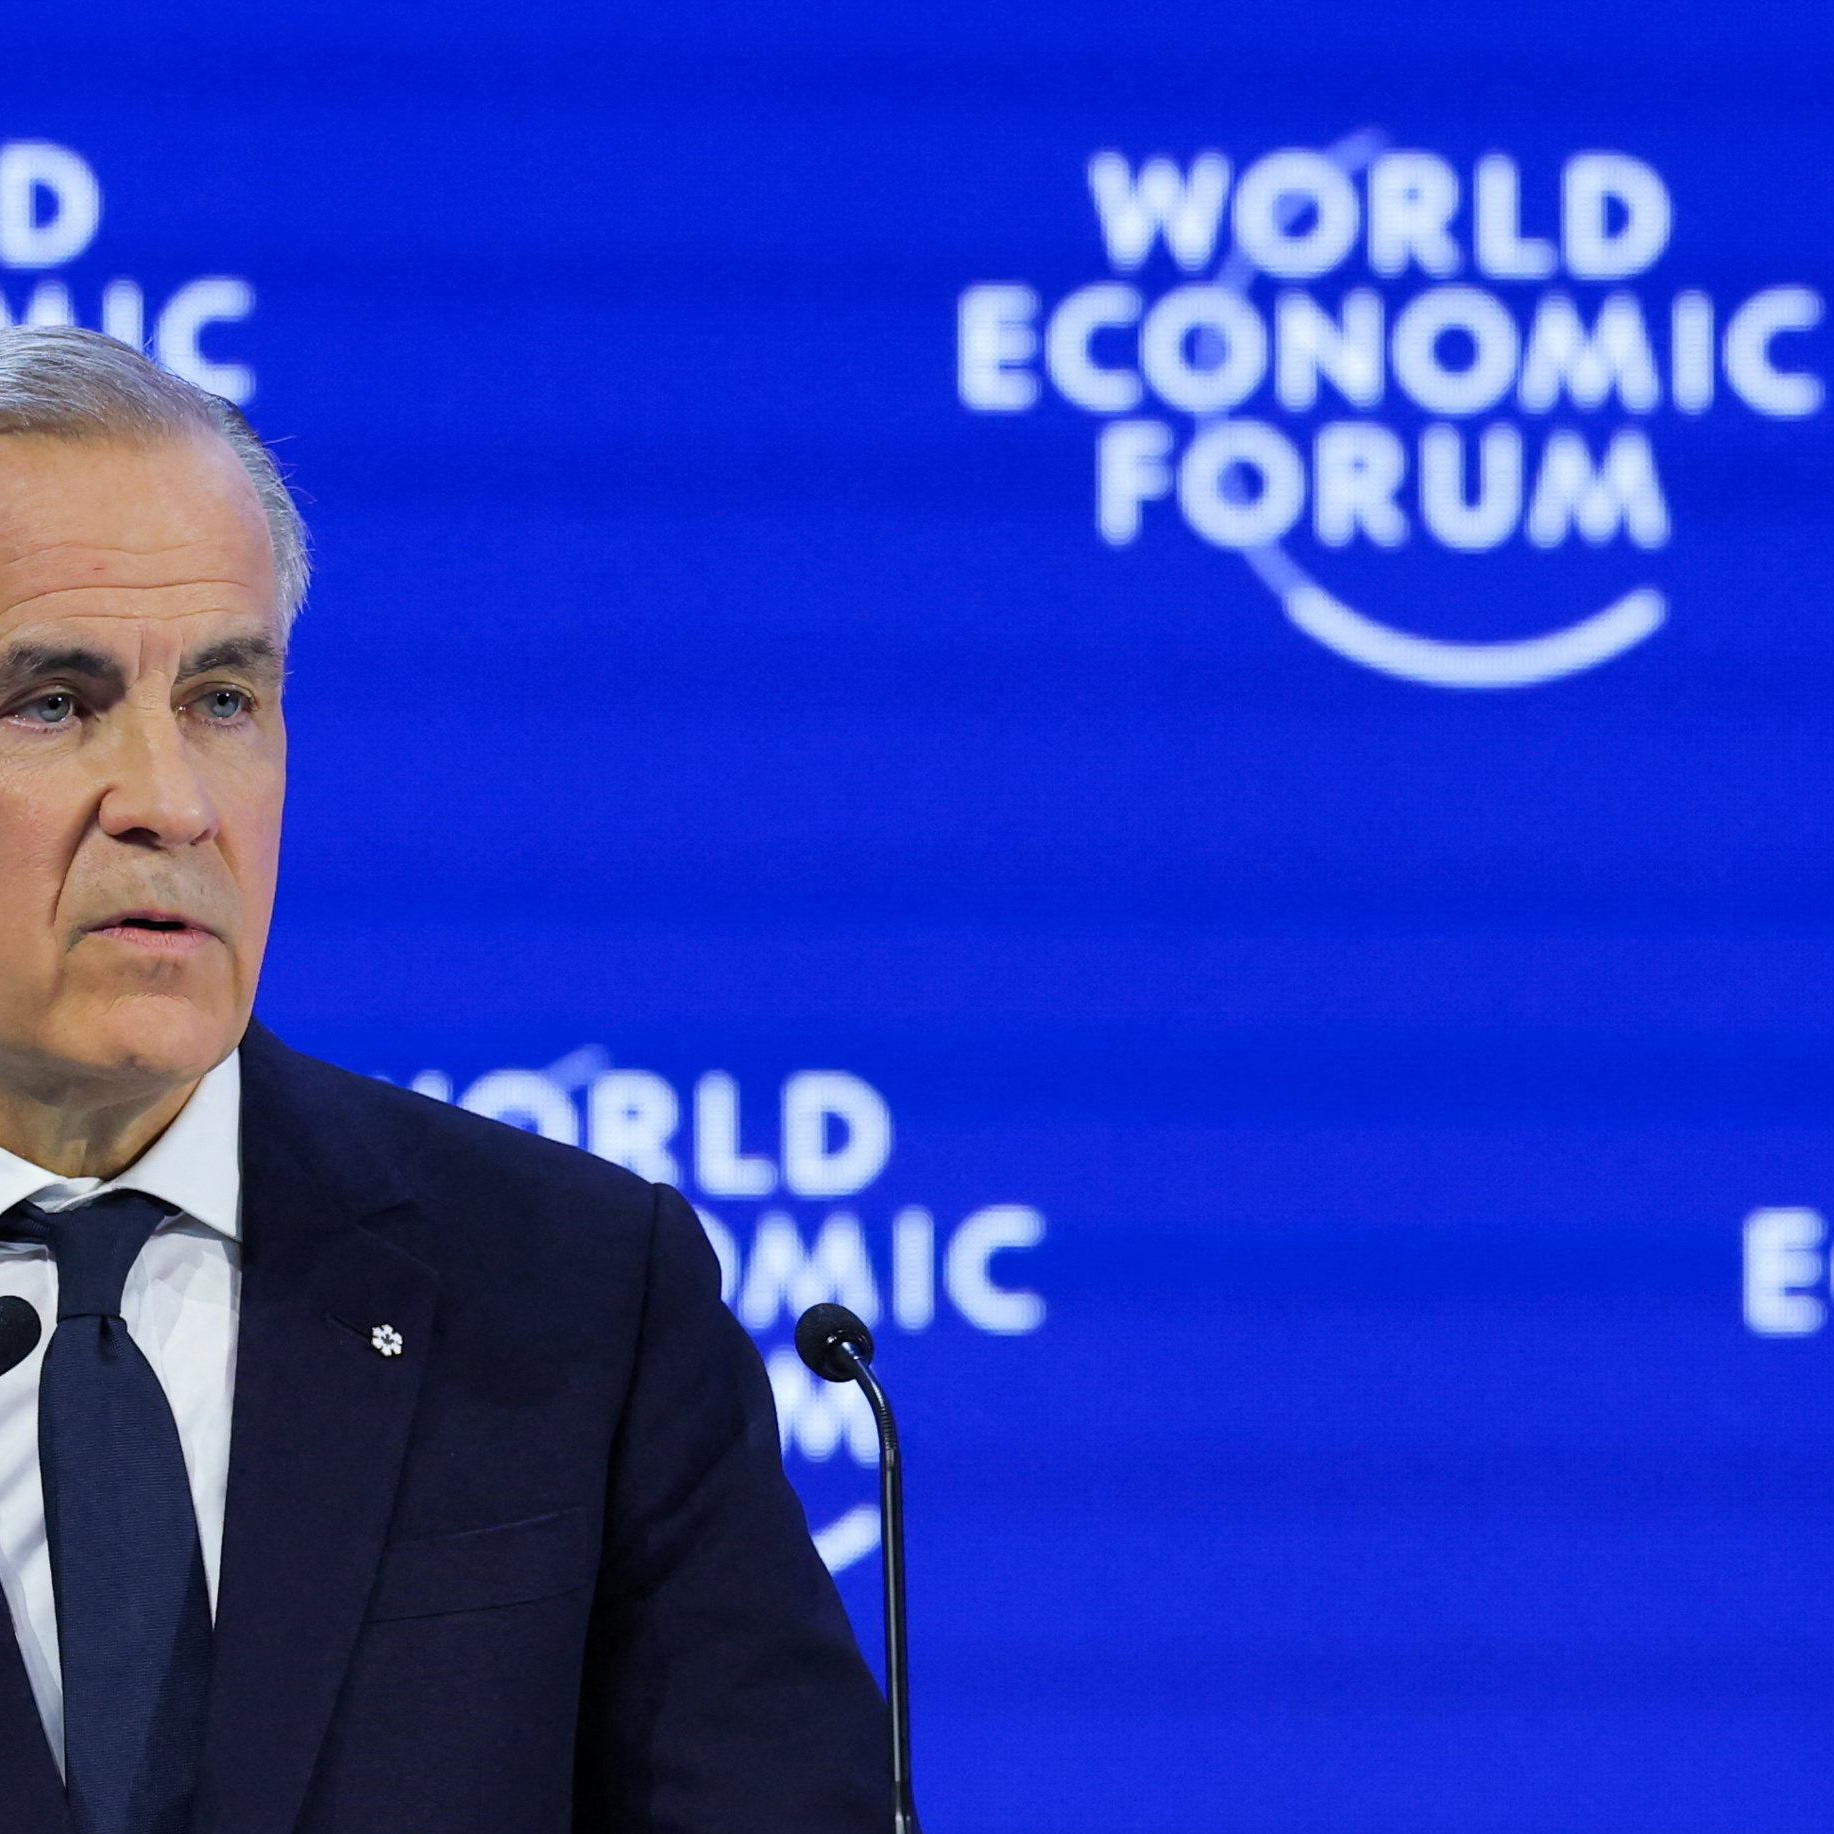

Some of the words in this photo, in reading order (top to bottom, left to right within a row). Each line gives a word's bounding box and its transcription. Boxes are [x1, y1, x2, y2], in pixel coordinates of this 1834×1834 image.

[1090, 150, 1672, 280] WORLD
[956, 283, 1820, 417] ECONOMIC
[1098, 419, 1668, 550] FORUM
[370, 1069, 892, 1197] RLD
